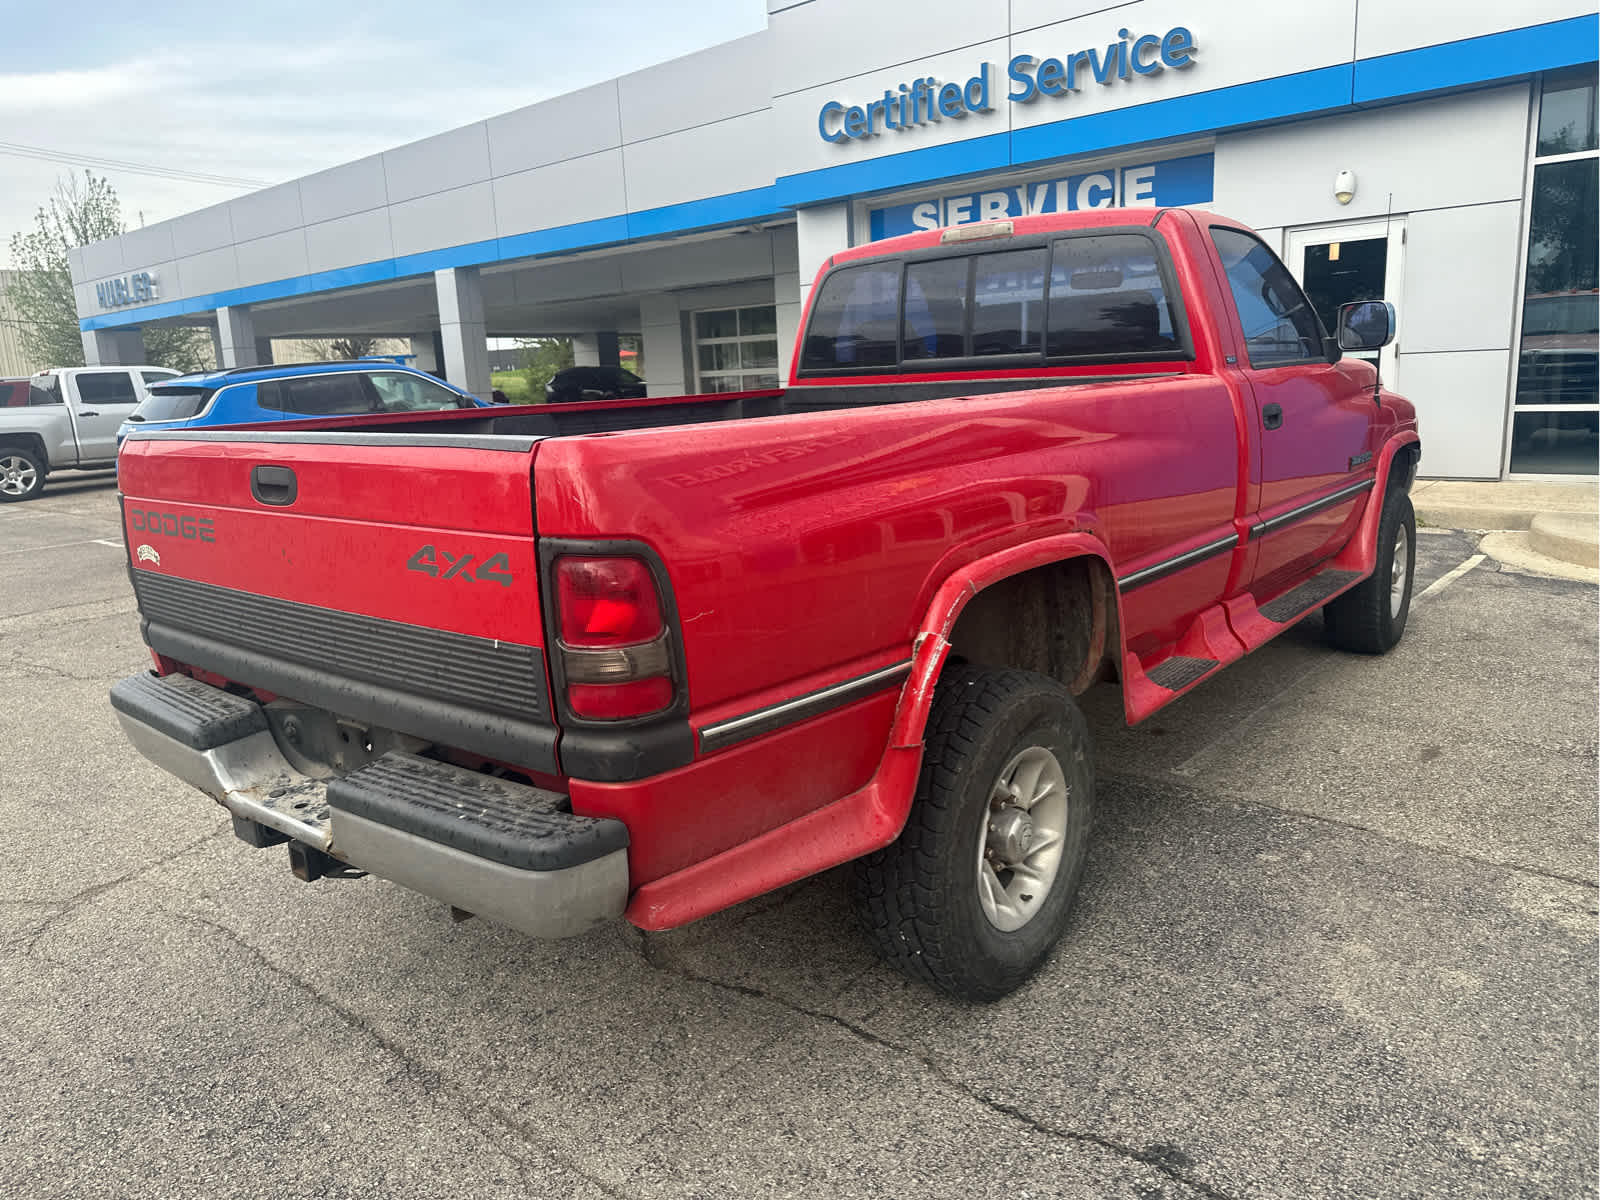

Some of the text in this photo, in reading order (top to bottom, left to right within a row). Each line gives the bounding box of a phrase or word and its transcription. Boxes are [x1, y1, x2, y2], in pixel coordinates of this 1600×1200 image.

[818, 26, 1194, 144] Certified Service
[911, 166, 1156, 232] SERVICE
[96, 272, 154, 307] HUBLER
[131, 508, 216, 544] DODGE
